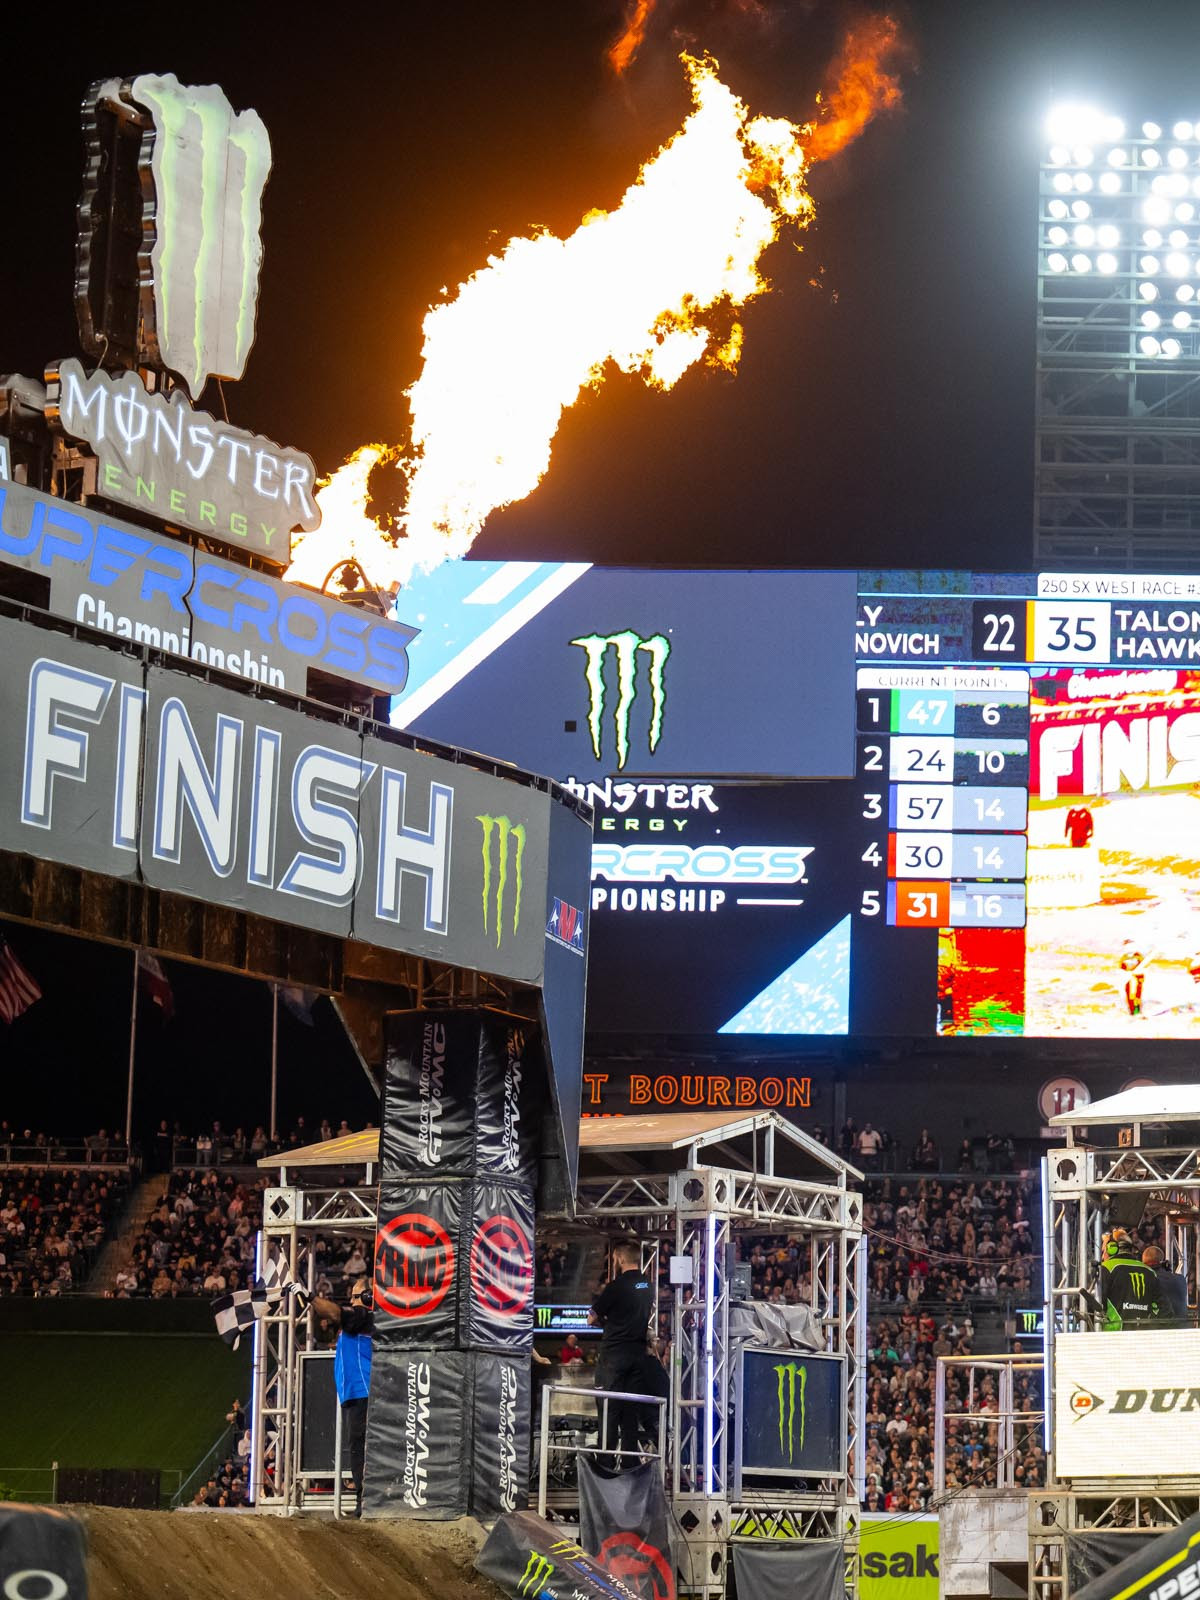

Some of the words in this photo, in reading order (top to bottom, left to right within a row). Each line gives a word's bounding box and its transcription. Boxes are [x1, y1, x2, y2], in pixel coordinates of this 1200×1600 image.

[66, 373, 314, 518] MONSTER
[104, 463, 278, 546] ENERGY
[1042, 579, 1068, 593] 250
[1072, 580, 1090, 594] SX
[1096, 580, 1136, 595] WEST
[1142, 581, 1182, 595] RACE
[76, 593, 286, 690] Championship
[855, 632, 940, 656] NOVICH
[982, 613, 1016, 652] 22
[1047, 616, 1097, 652] 35
[878, 675, 949, 688] CURRENT
[954, 676, 1009, 689] POINTS
[867, 697, 880, 723] 1
[906, 699, 948, 726] 47
[982, 702, 1001, 726] 6
[864, 745, 883, 771] 2
[906, 749, 946, 772] 24
[975, 750, 1006, 774] 10
[20, 656, 456, 938] FINISH
[560, 776, 720, 813] ONSTER
[862, 793, 883, 819] 3
[906, 797, 944, 820] 57
[973, 798, 1006, 822] 14
[600, 817, 689, 832] ERGY
[861, 842, 883, 867] 4
[904, 845, 944, 868] 30
[972, 846, 1005, 870] 14
[592, 887, 726, 912] PIONSHIP
[860, 890, 880, 915] 5
[906, 892, 940, 918] 31
[973, 895, 1003, 917] 16
[545, 895, 585, 952] AMA
[419, 1021, 433, 1099] MOUNTAIN
[629, 1074, 812, 1108] BOURBON
[1052, 1087, 1076, 1116] 11
[418, 1099, 431, 1145] ROCKY
[502, 1102, 511, 1146] ROCKY
[405, 1361, 418, 1440] MOUNTAIN
[498, 1365, 508, 1442] MOUNTAIN
[404, 1440, 416, 1487] ROCKY
[499, 1443, 508, 1491] ROCKY
